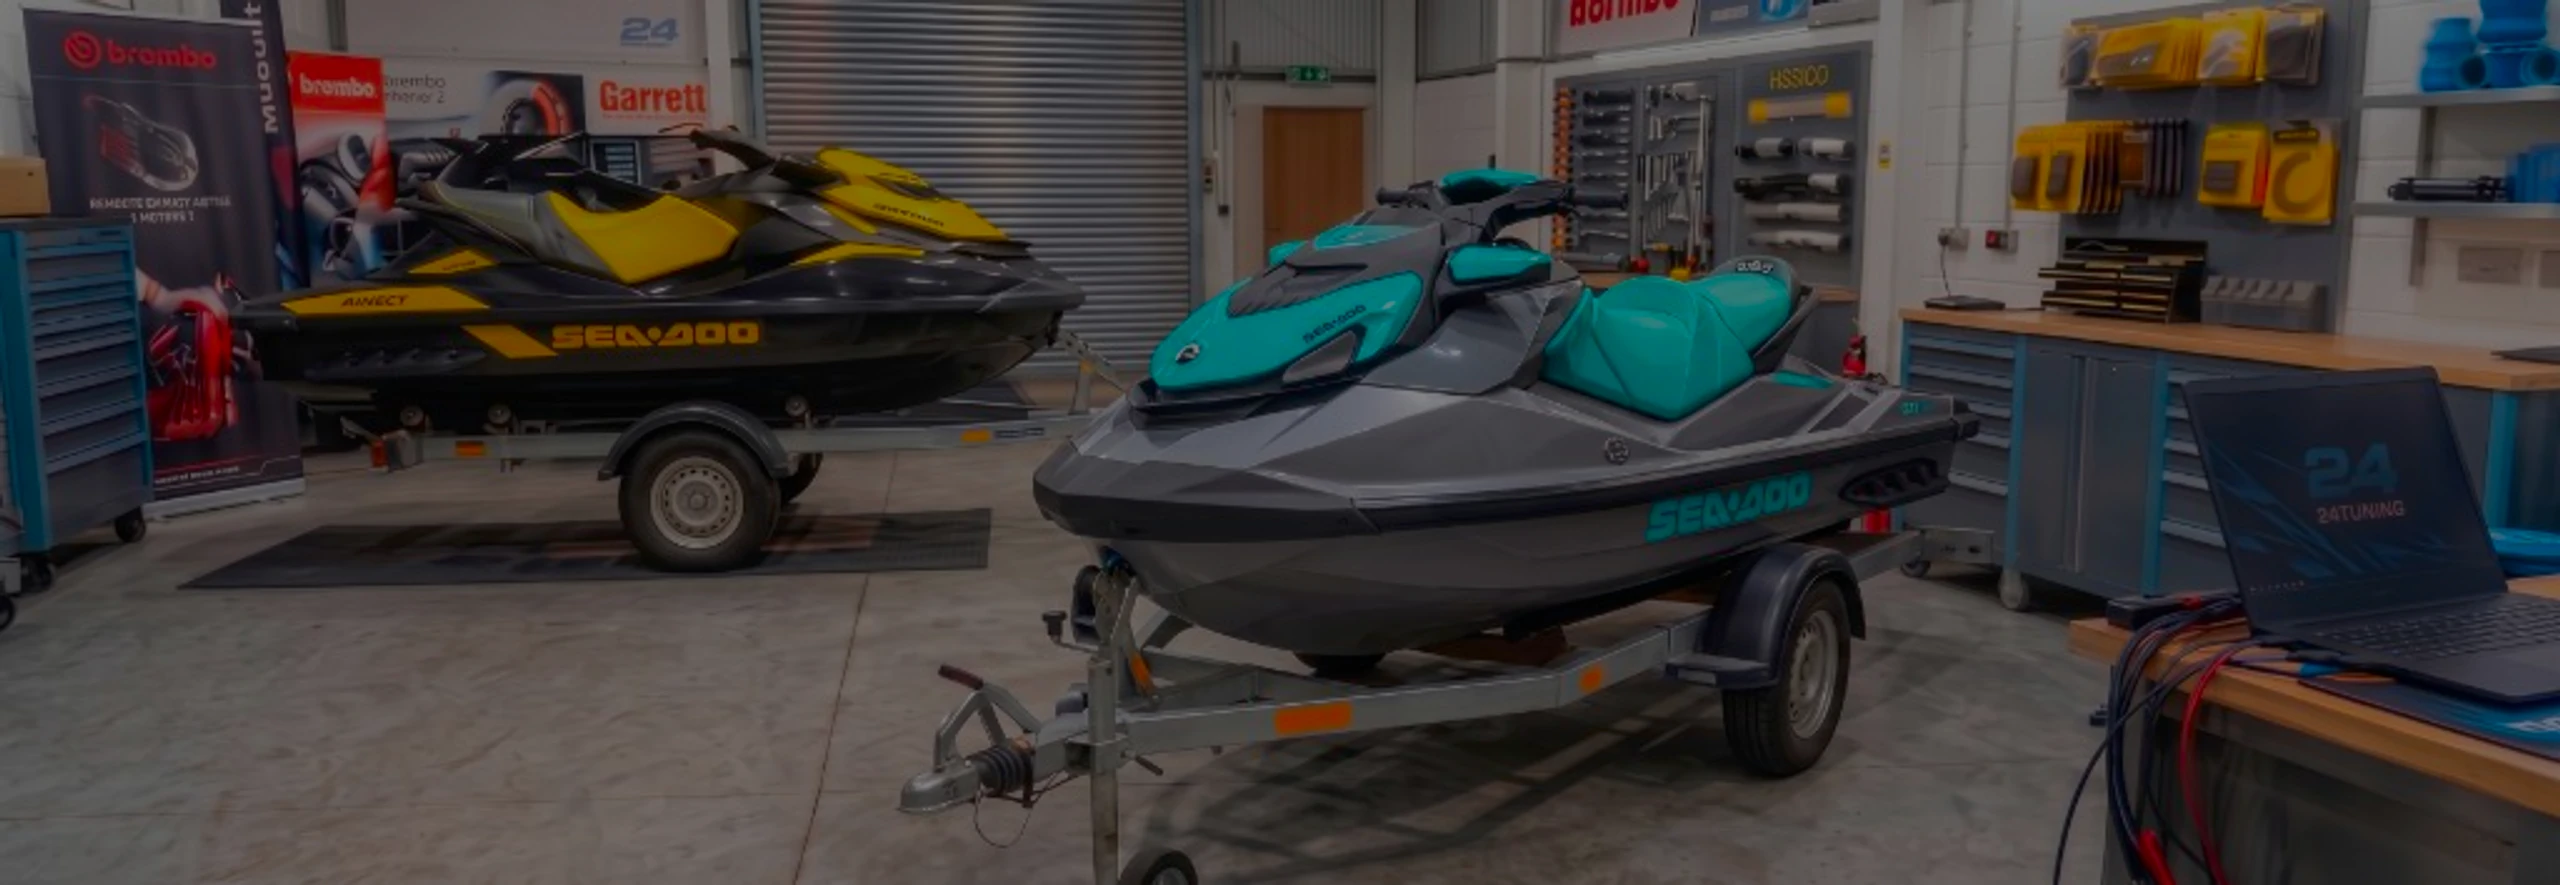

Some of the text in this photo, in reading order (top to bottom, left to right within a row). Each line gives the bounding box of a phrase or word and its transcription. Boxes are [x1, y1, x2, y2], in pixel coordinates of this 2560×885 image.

[620, 17, 679, 41] 24
[107, 39, 217, 70] brembo
[299, 72, 377, 98] brembo
[600, 80, 706, 113] Garrett
[2304, 442, 2398, 498] 24
[2315, 500, 2405, 524] 24TUNING
